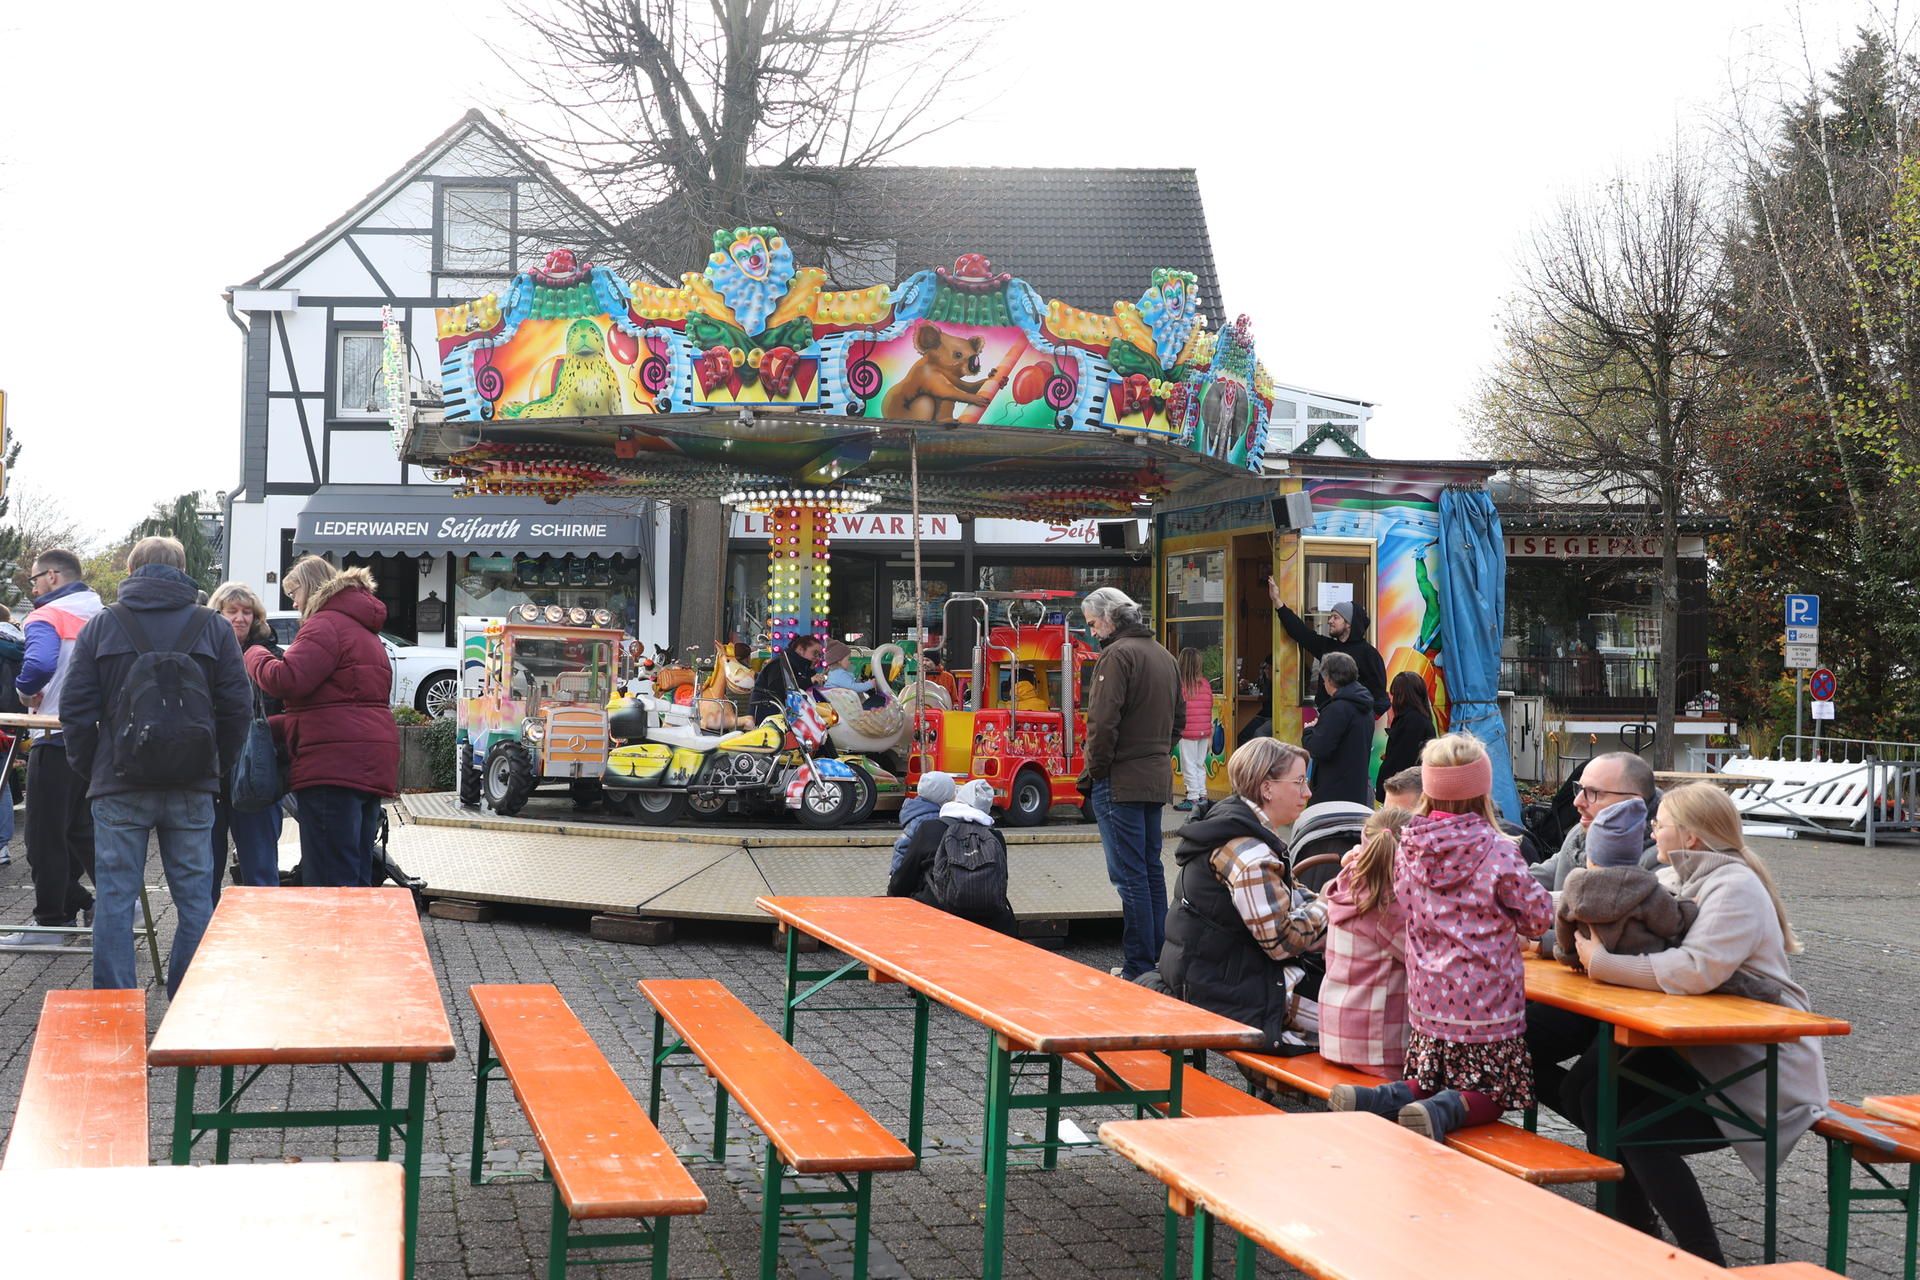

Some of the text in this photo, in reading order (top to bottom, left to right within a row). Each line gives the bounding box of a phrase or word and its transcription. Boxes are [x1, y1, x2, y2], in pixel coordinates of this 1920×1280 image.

[314, 516, 607, 543] LEDERWAREN Seifarth SCHIRME
[744, 514, 947, 535] LERWAREN
[1045, 519, 1100, 544] Seif
[1791, 598, 1808, 622] P
